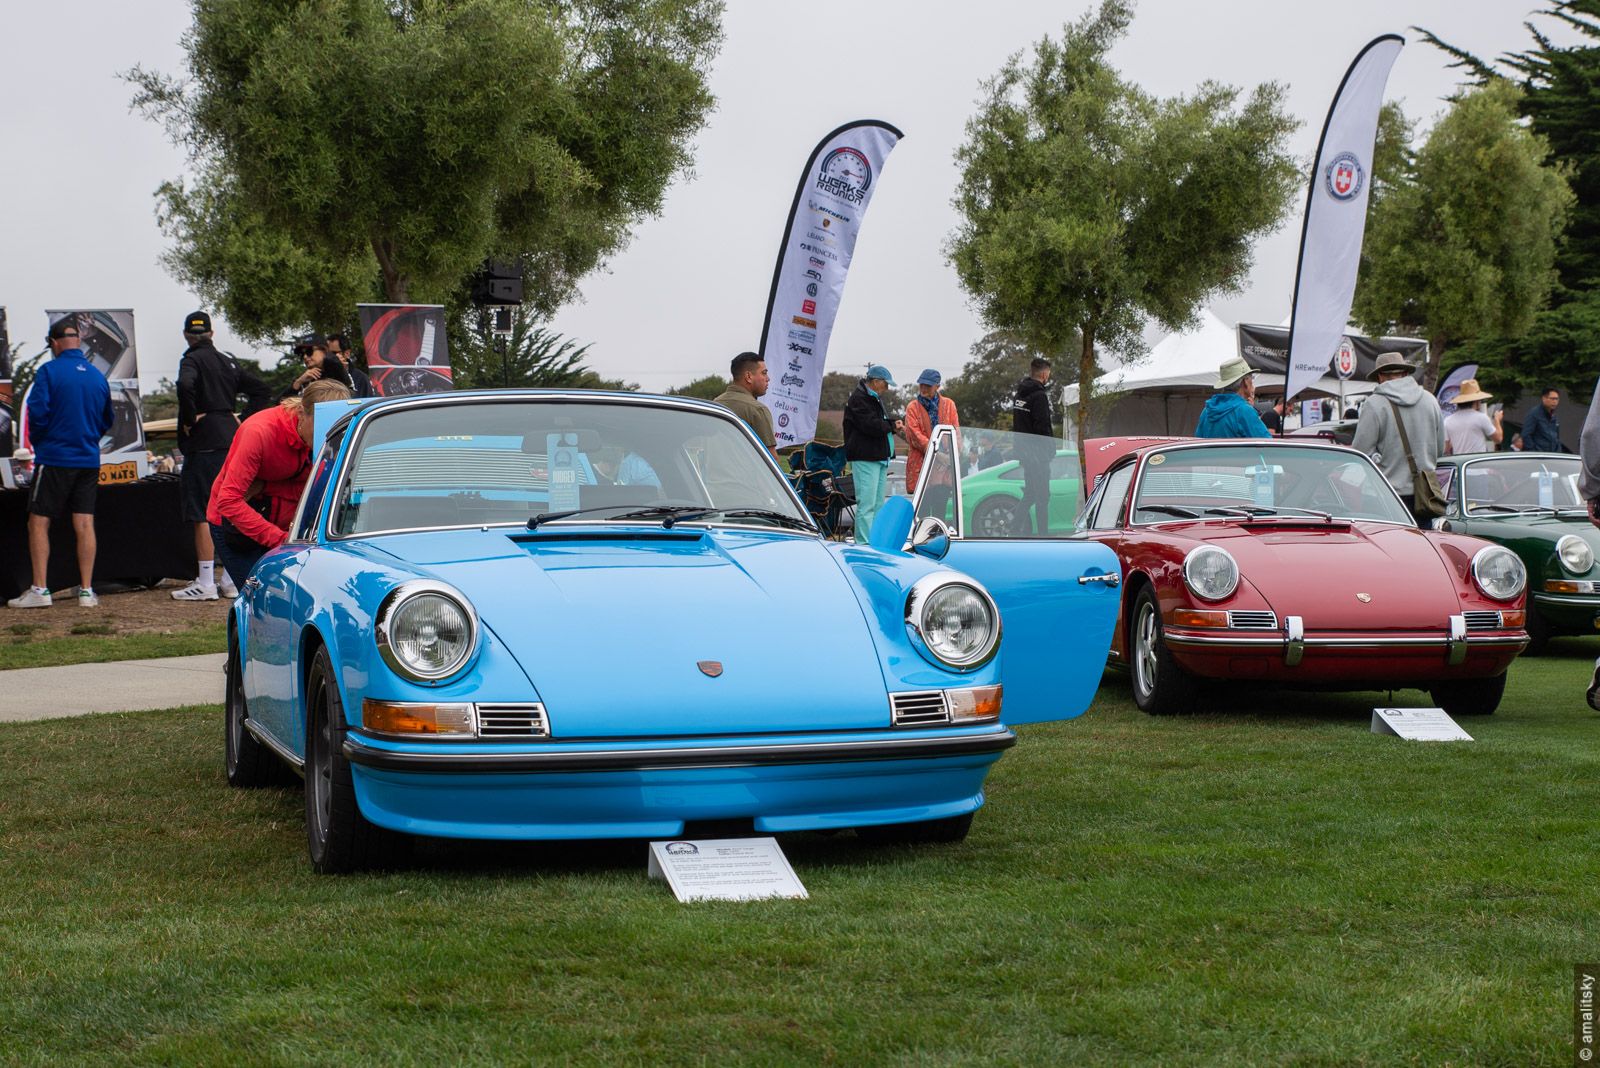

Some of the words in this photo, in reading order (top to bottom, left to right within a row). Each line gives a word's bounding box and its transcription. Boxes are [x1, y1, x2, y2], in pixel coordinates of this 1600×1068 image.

[816, 181, 862, 206] REUNION
[818, 172, 865, 200] WERKS
[818, 206, 850, 222] MICHELIN
[788, 342, 814, 356] XPEL
[774, 400, 798, 413] deluxe
[111, 470, 135, 481] MATS
